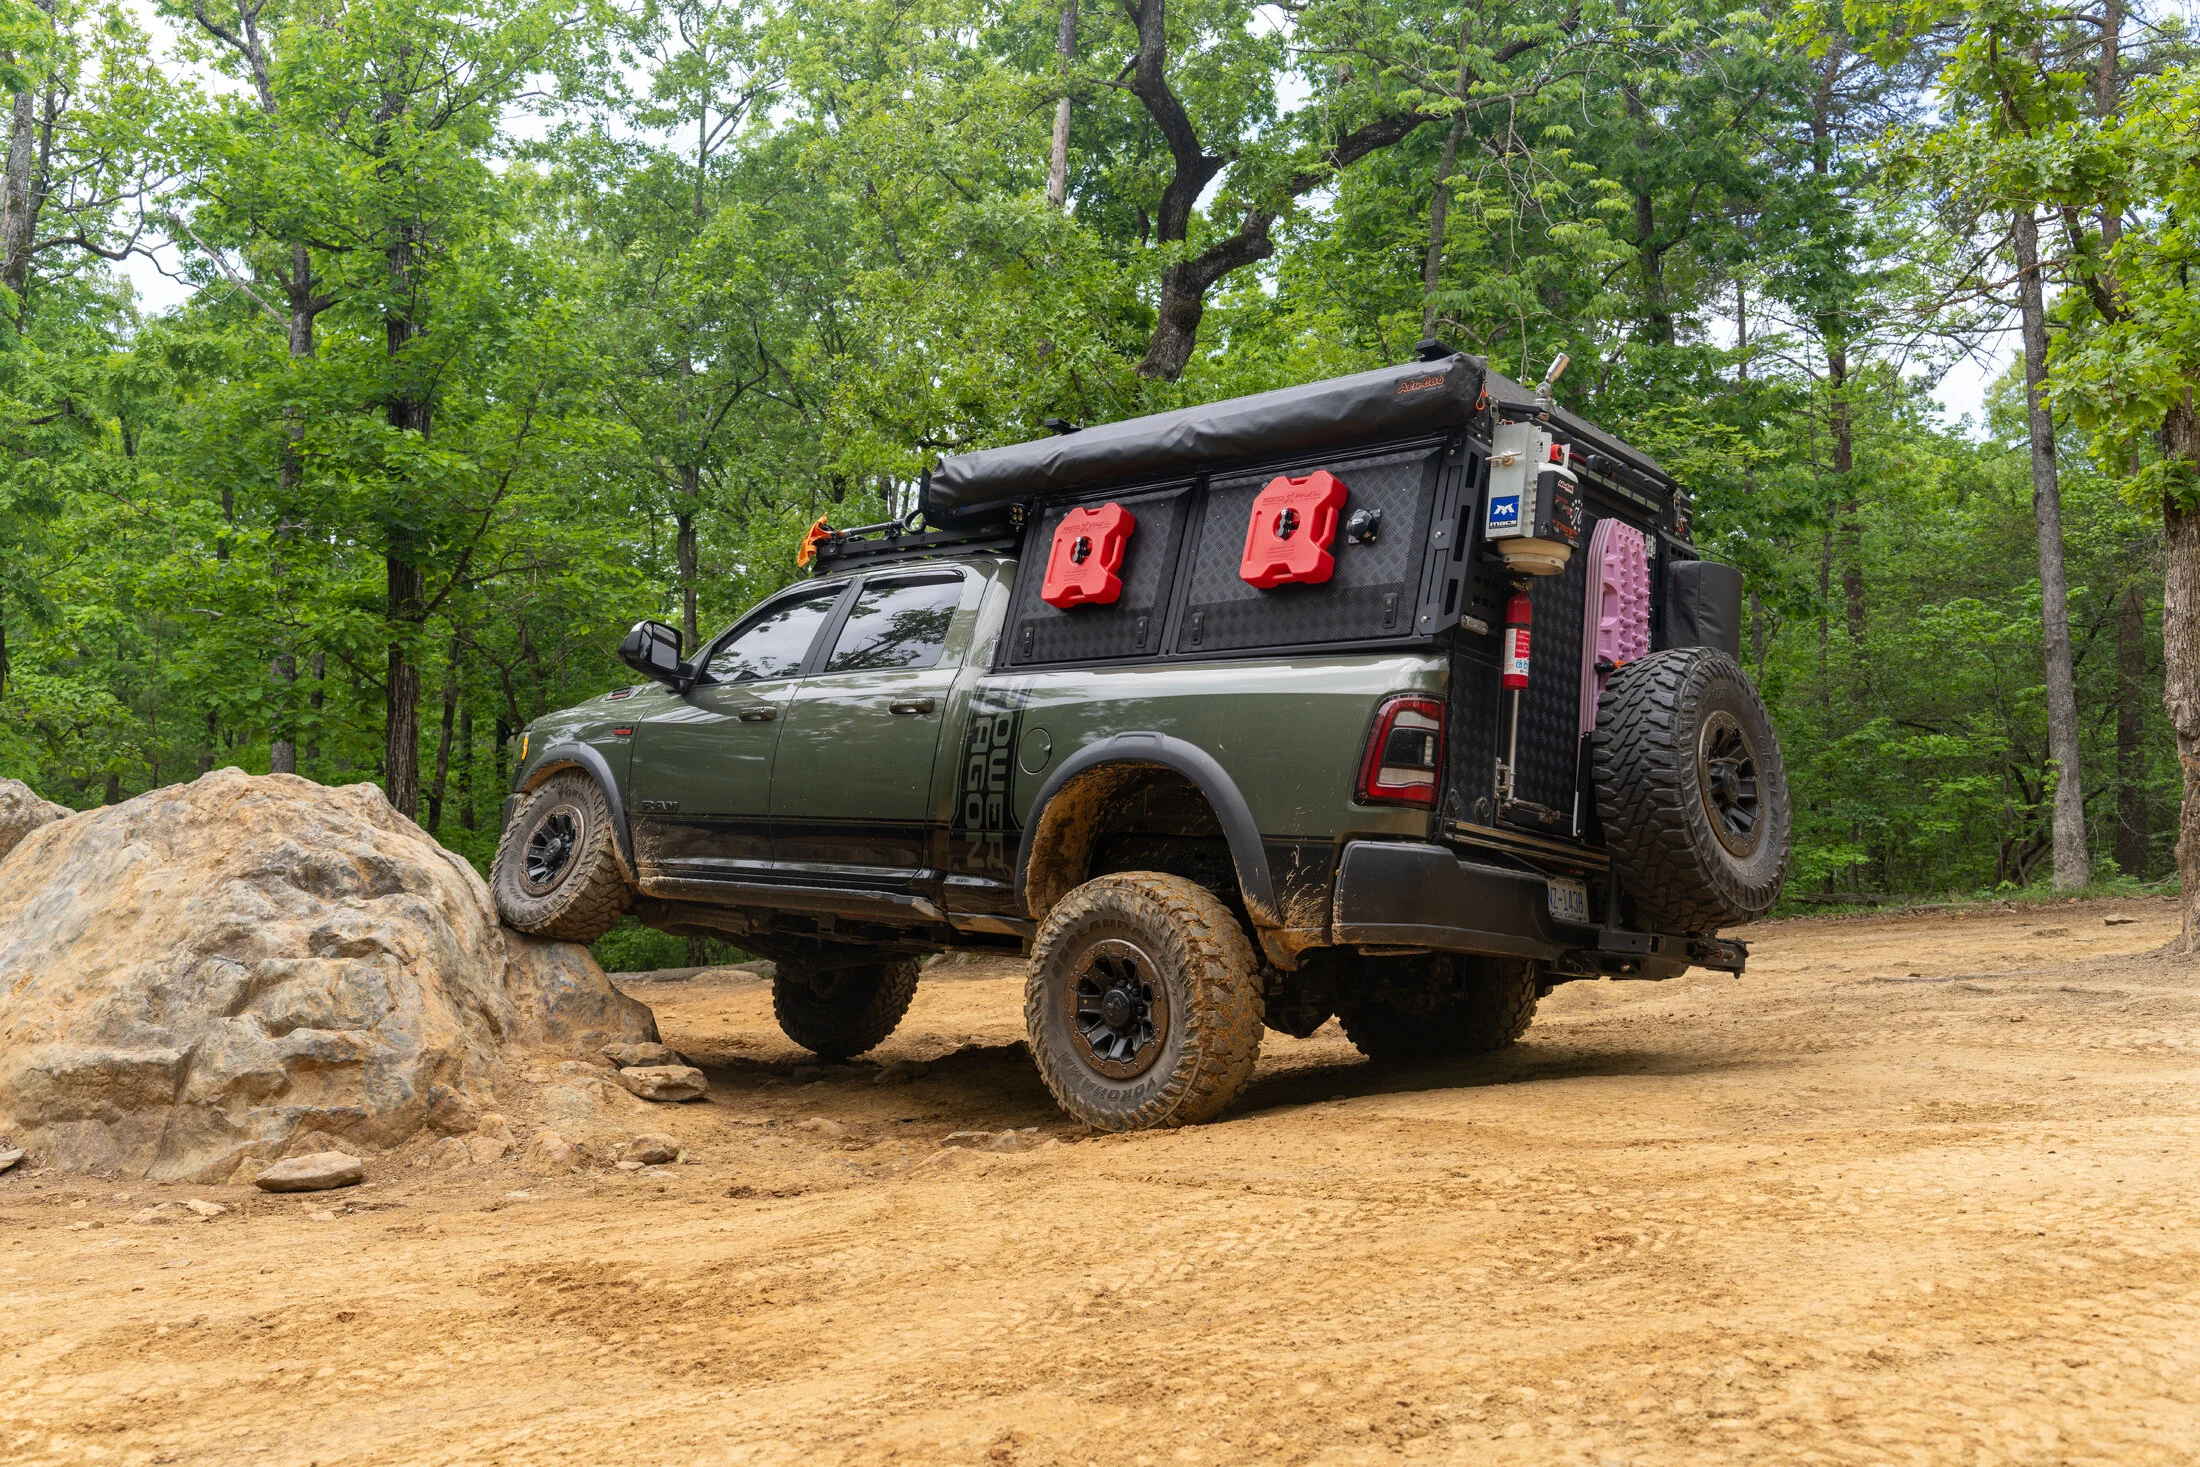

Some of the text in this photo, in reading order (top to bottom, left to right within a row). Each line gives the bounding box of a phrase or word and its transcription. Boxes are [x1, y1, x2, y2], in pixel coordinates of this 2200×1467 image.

[965, 680, 999, 868] WAGON
[985, 678, 1021, 870] POWER
[1059, 1050, 1157, 1102] YOKOHAMA
